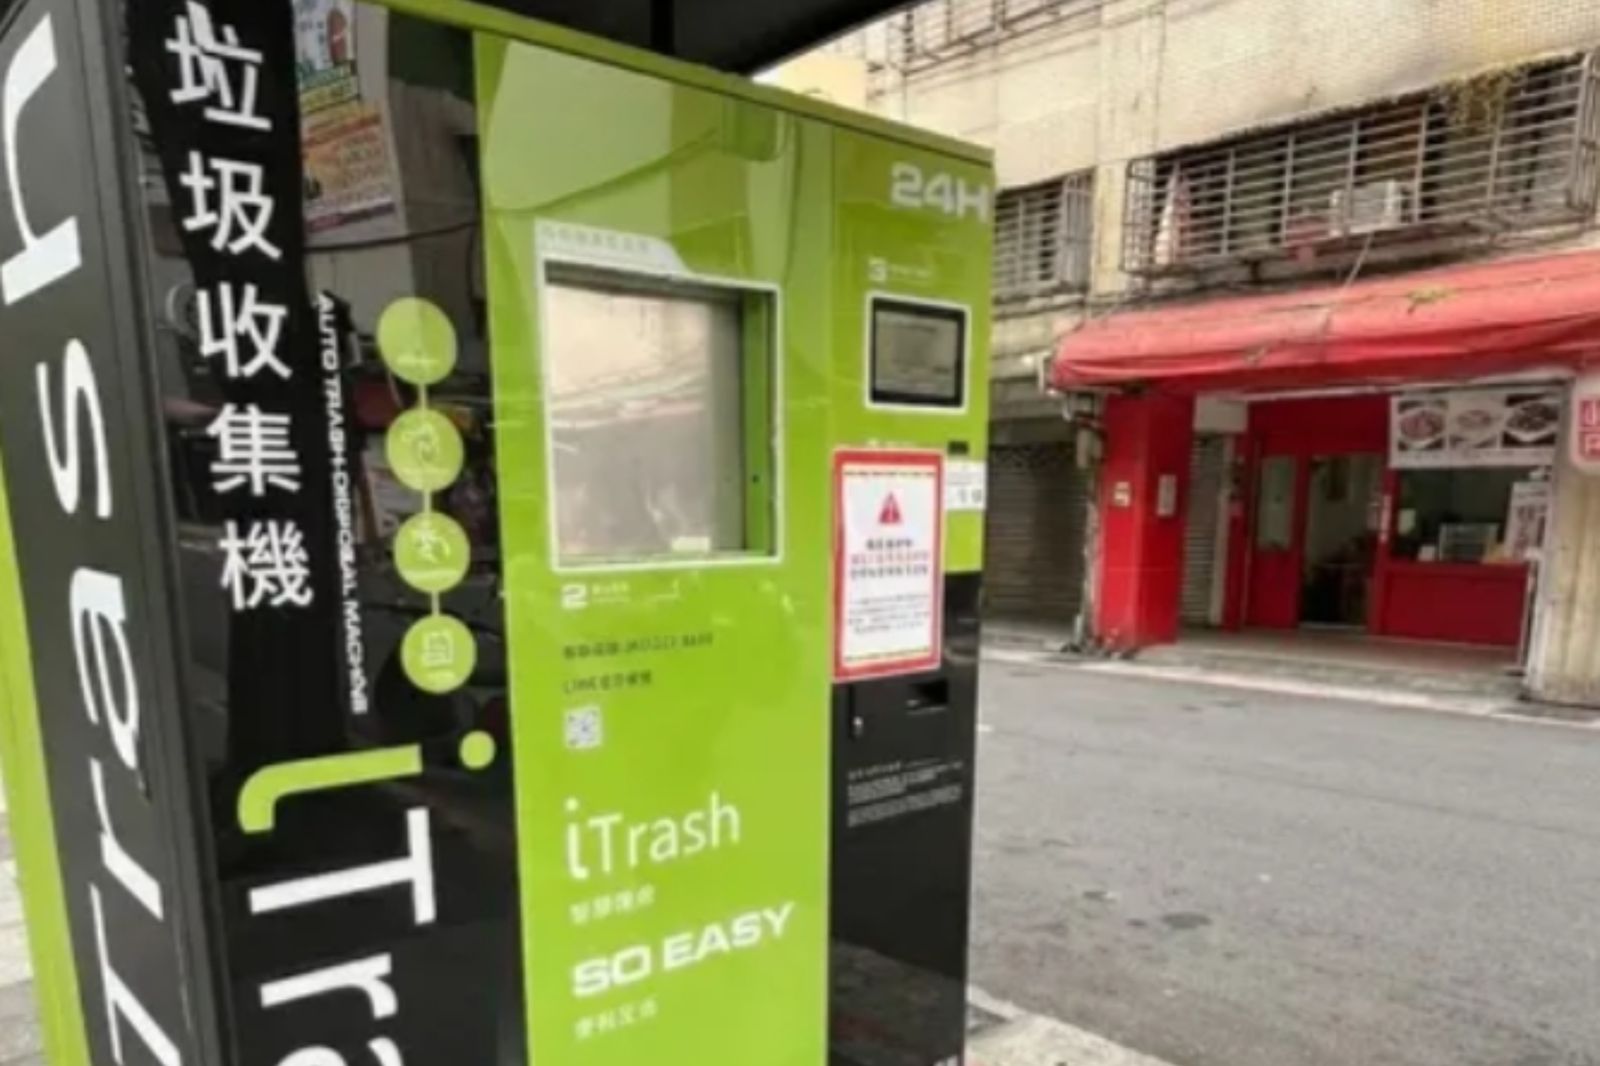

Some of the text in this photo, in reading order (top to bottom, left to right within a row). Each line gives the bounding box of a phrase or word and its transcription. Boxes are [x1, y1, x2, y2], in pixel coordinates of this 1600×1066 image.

[891, 163, 989, 223] 24H
[165, 1, 313, 610] 垃圾收集機
[314, 294, 338, 371] AUTO
[561, 583, 588, 609] 2
[563, 790, 741, 880] iTrash
[572, 944, 652, 998] SO
[662, 900, 796, 972] EASY
